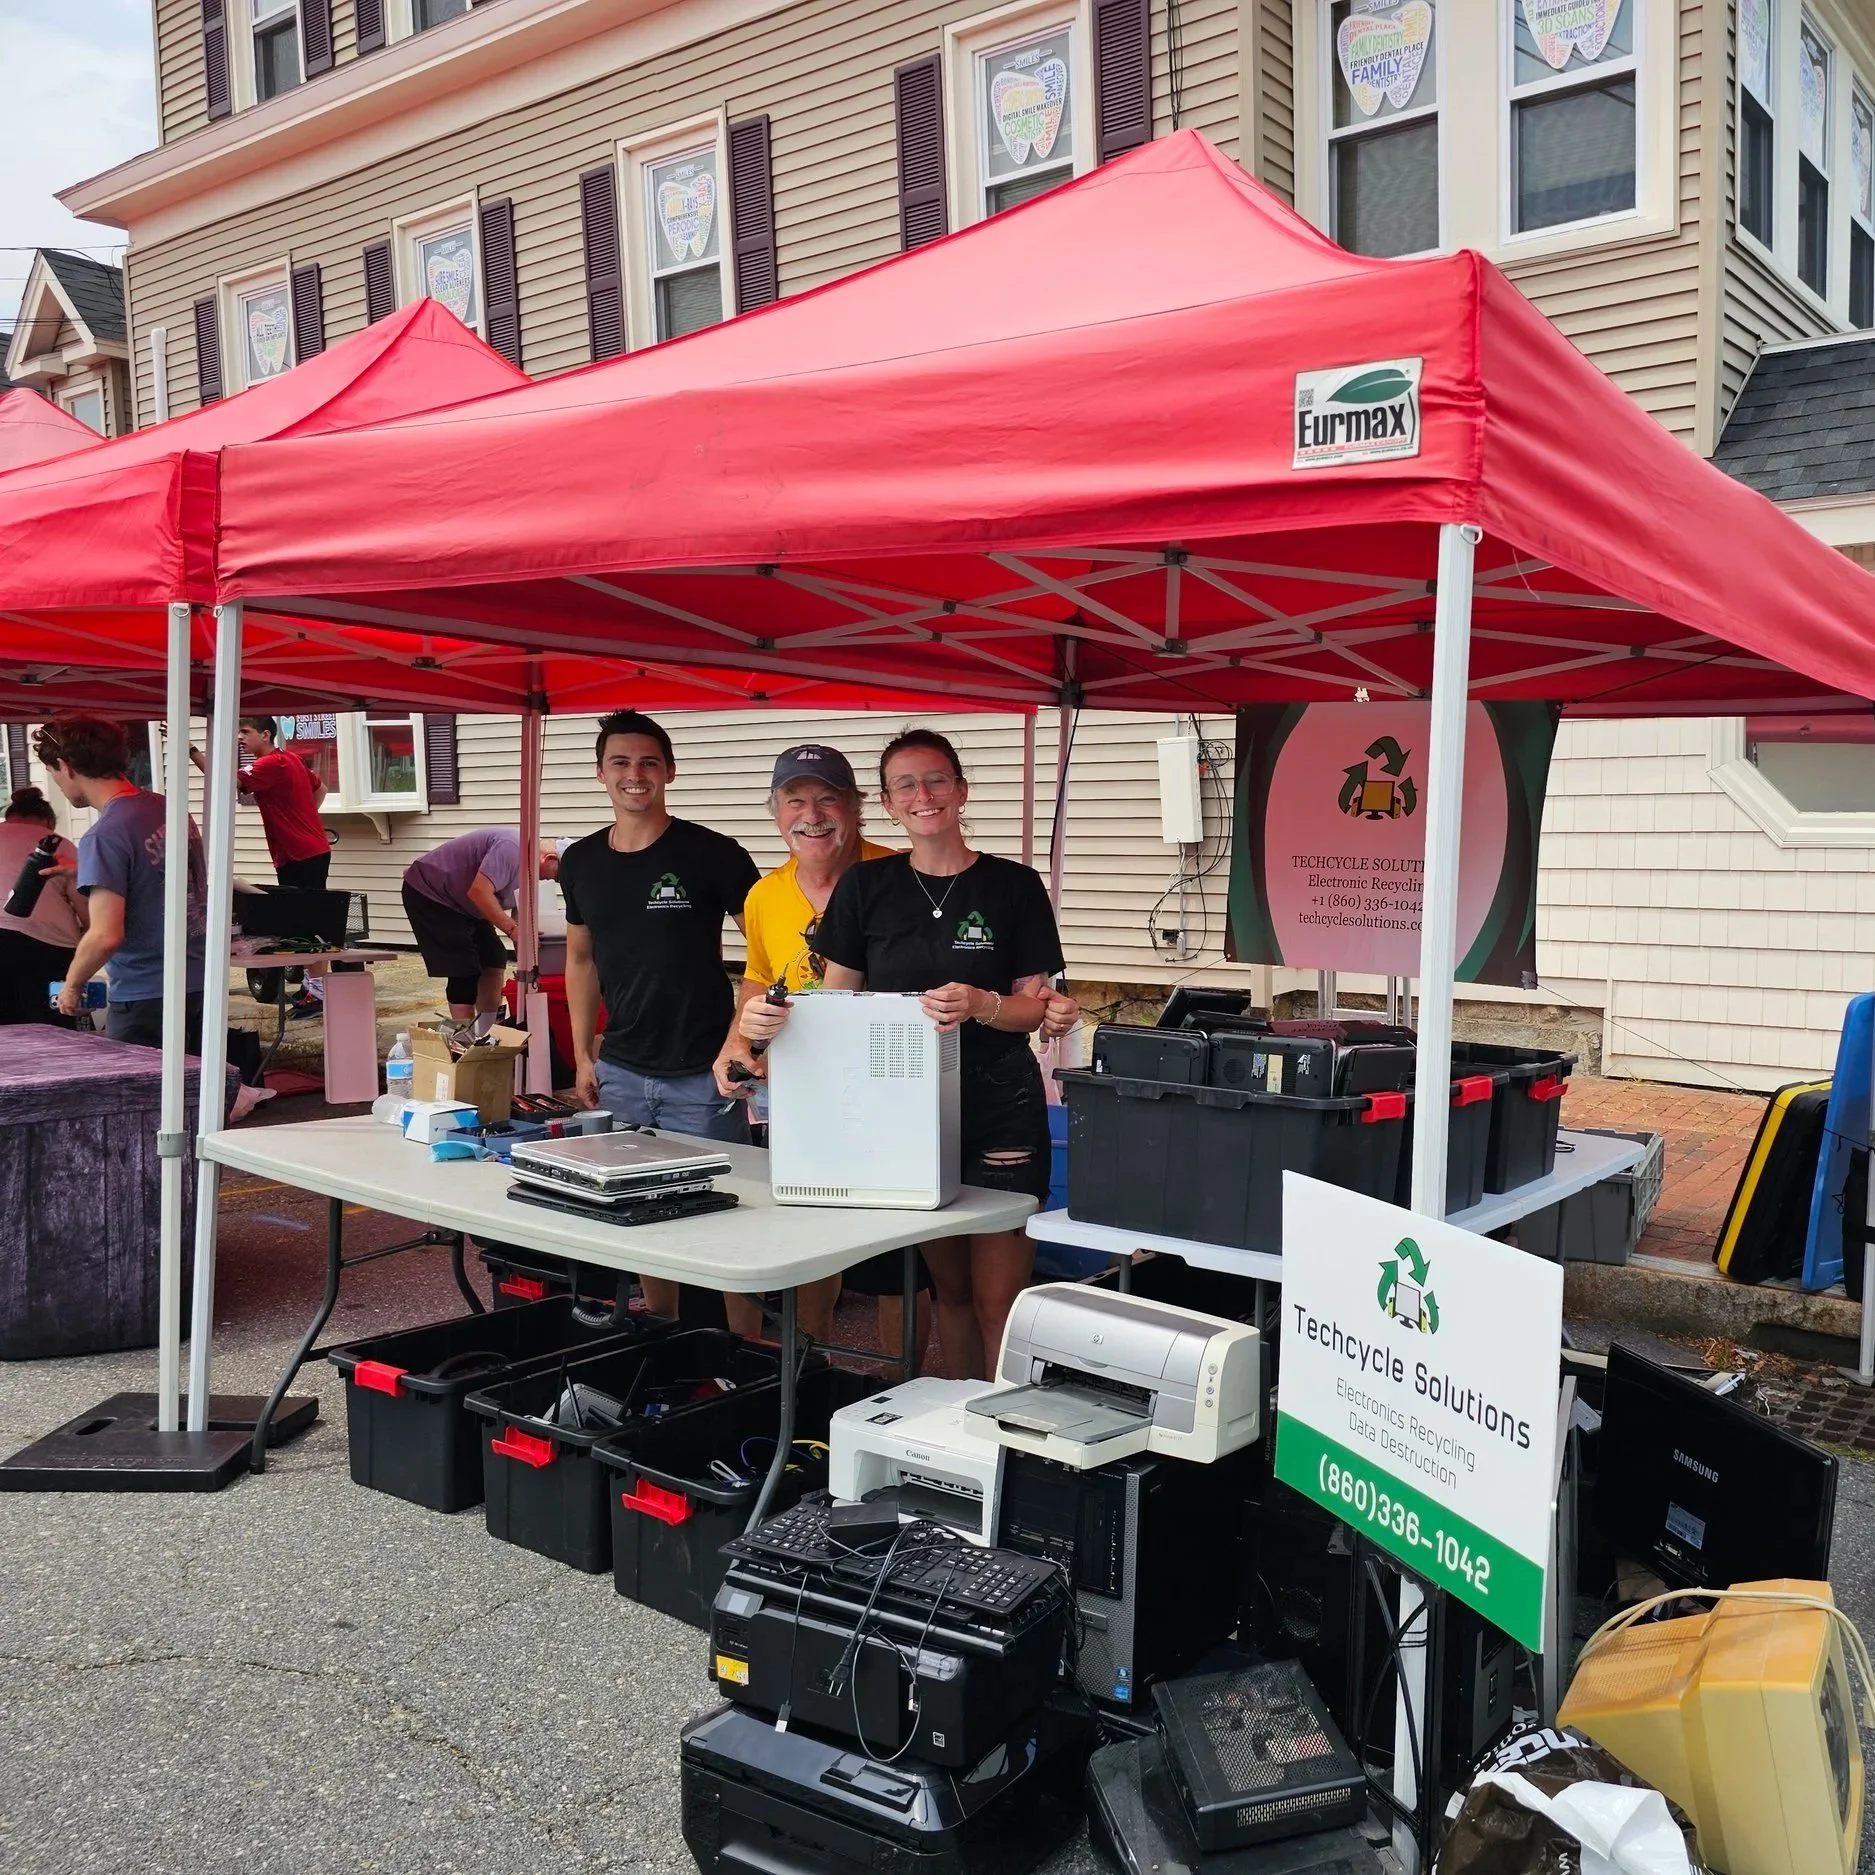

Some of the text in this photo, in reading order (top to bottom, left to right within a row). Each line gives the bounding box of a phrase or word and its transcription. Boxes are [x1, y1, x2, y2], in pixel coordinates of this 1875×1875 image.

[1535, 5, 1567, 20] IMMEDIATE
[1537, 18, 1553, 35] 3D
[1555, 6, 1595, 29] SCANS
[1350, 41, 1424, 70] FRIENDLY DENTAL PLACE
[1044, 63, 1057, 101] SMILE
[1351, 57, 1404, 85] FAMILY
[1002, 110, 1021, 123] DIGITAL
[1021, 105, 1037, 118] SMILE
[1036, 97, 1063, 113] MAKEOVER
[1004, 112, 1045, 137] COSMETIC
[1298, 403, 1407, 449] Eurmax
[296, 720, 337, 740] SMILES
[1291, 855, 1369, 870] TECHCYCLE
[1308, 874, 1368, 889] Electronic
[1311, 895, 1325, 907] +1
[1328, 893, 1361, 909] (860)
[1294, 1303, 1531, 1450] Techcycle Solutions
[1337, 1377, 1476, 1473] Electronics Recycling
[906, 1449, 930, 1462] Canon
[1349, 1411, 1457, 1489] Data Destruction
[1673, 1448, 1719, 1483] SAMSUNG
[1318, 1453, 1492, 1595] (860)336-1042
